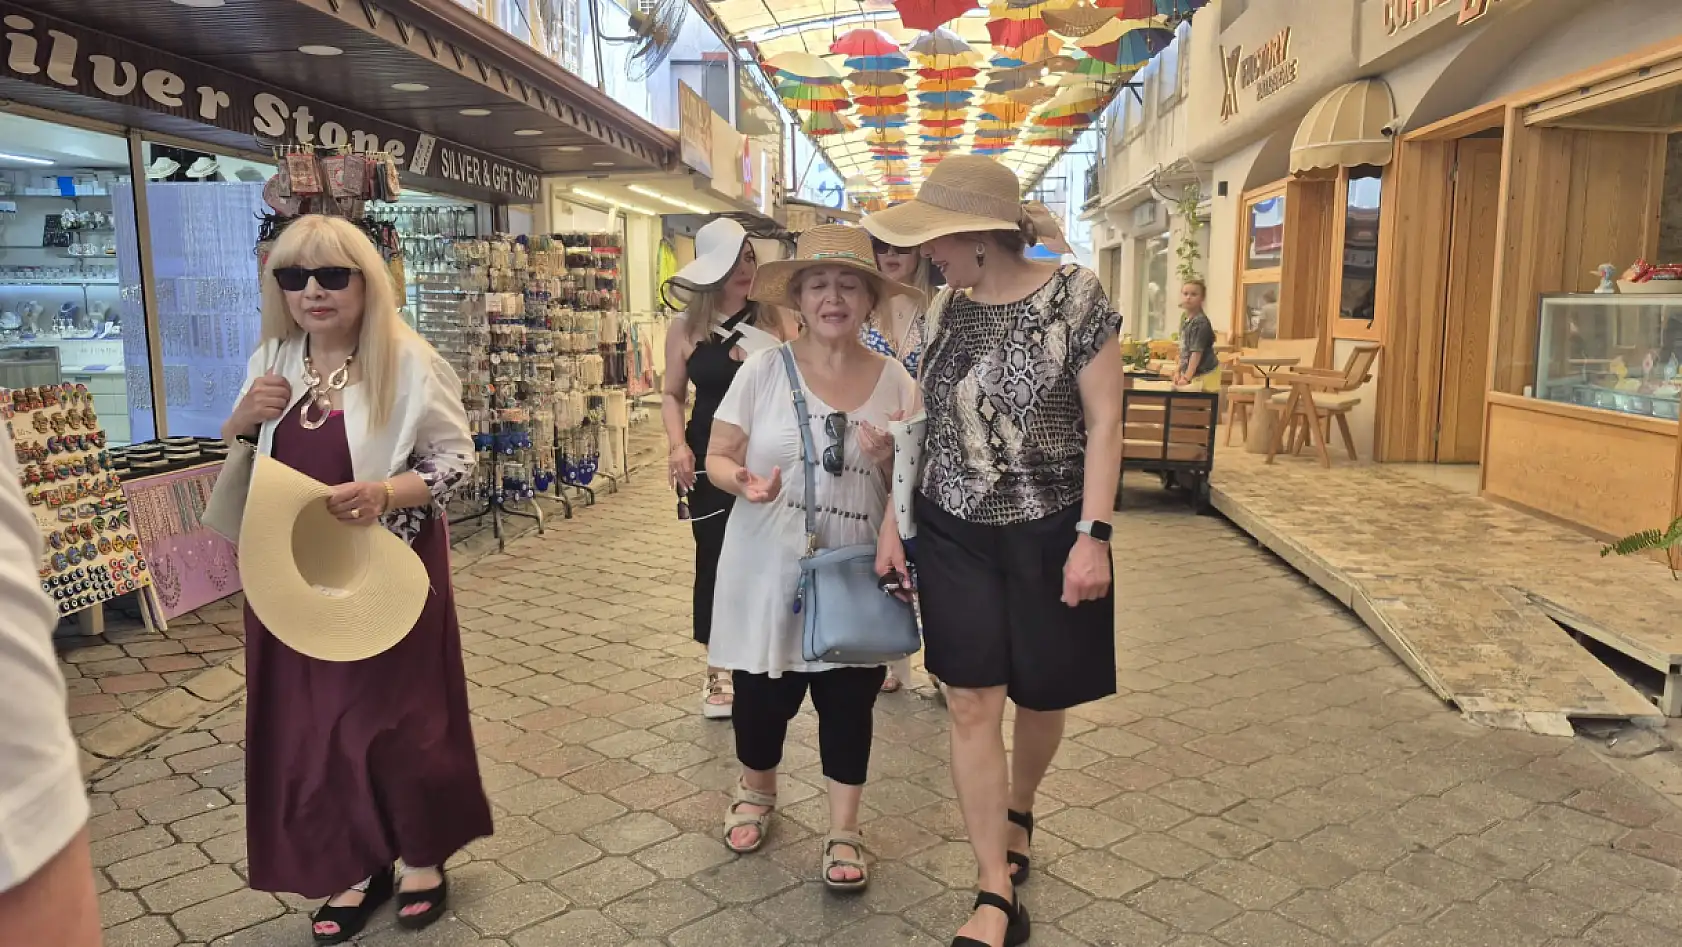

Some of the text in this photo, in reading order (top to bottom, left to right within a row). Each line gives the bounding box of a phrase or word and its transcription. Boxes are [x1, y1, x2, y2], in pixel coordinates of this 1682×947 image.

[253, 92, 405, 165] Stone
[441, 147, 540, 200] SILVER & GIFT SHOP
